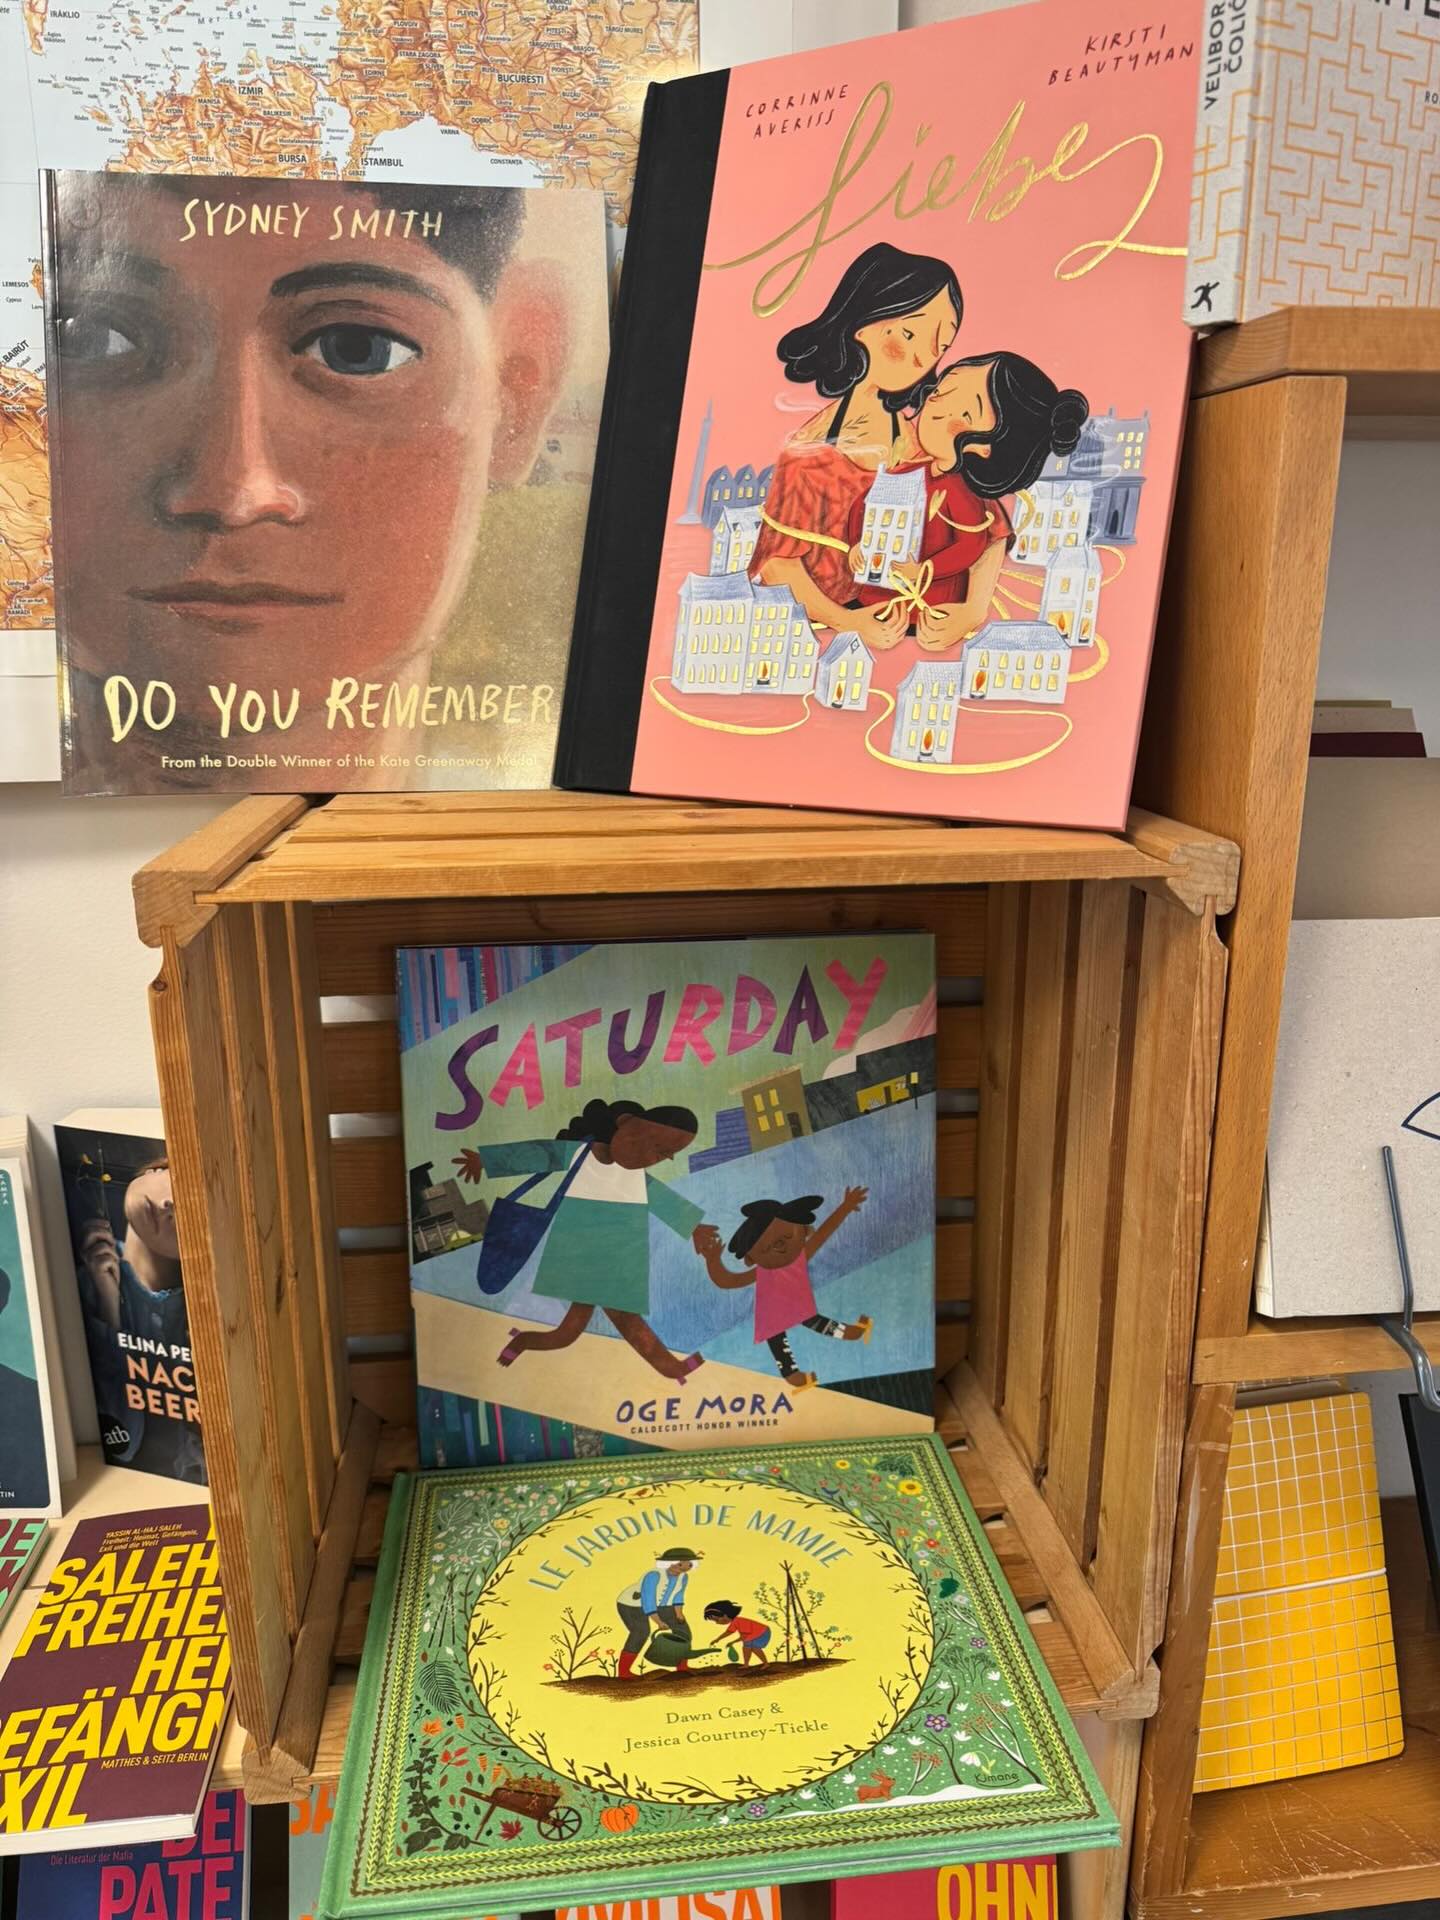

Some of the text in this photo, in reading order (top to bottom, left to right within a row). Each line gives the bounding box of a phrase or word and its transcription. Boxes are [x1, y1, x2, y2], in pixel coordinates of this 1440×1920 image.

[1085, 24, 1166, 56] KIRSTI
[1204, 1, 1226, 111] VELIBOR
[1048, 43, 1194, 87] BEAUTYMAN
[238, 86, 263, 95] IZMIR
[746, 84, 849, 119] CORRINNE
[753, 108, 836, 140] AVERISS
[278, 154, 307, 163] BURSA
[360, 157, 404, 168] ISTAMBUL
[179, 198, 442, 242] SYDNEY SMITH
[104, 675, 555, 743] DO YOU REMEMBER
[161, 754, 538, 770] From the Double Winner of the Kate Greenaway Medal
[434, 956, 889, 1130] SATURDAY
[117, 1332, 193, 1363] ELINA PE
[127, 1354, 195, 1393] NAC
[125, 1383, 202, 1425] BEER
[616, 1392, 794, 1424] OGE MORA
[104, 1425, 130, 1446] atb
[630, 1418, 779, 1434] CALDECOTT HONOR WINNER
[158, 1523, 183, 1532] SALEH
[528, 1503, 856, 1592] LE JARDIN DE MAMIE
[40, 1542, 220, 1606] SALEH
[666, 1702, 783, 1725] Dawn Casey &
[101, 1751, 209, 1770] MATTHES & SEITZ BERLIN
[623, 1735, 681, 1754] Jessica
[50, 1849, 133, 1866] Die Literatur der Mafia
[98, 1856, 235, 1920] PATE
[937, 1862, 1060, 1920] OHN
